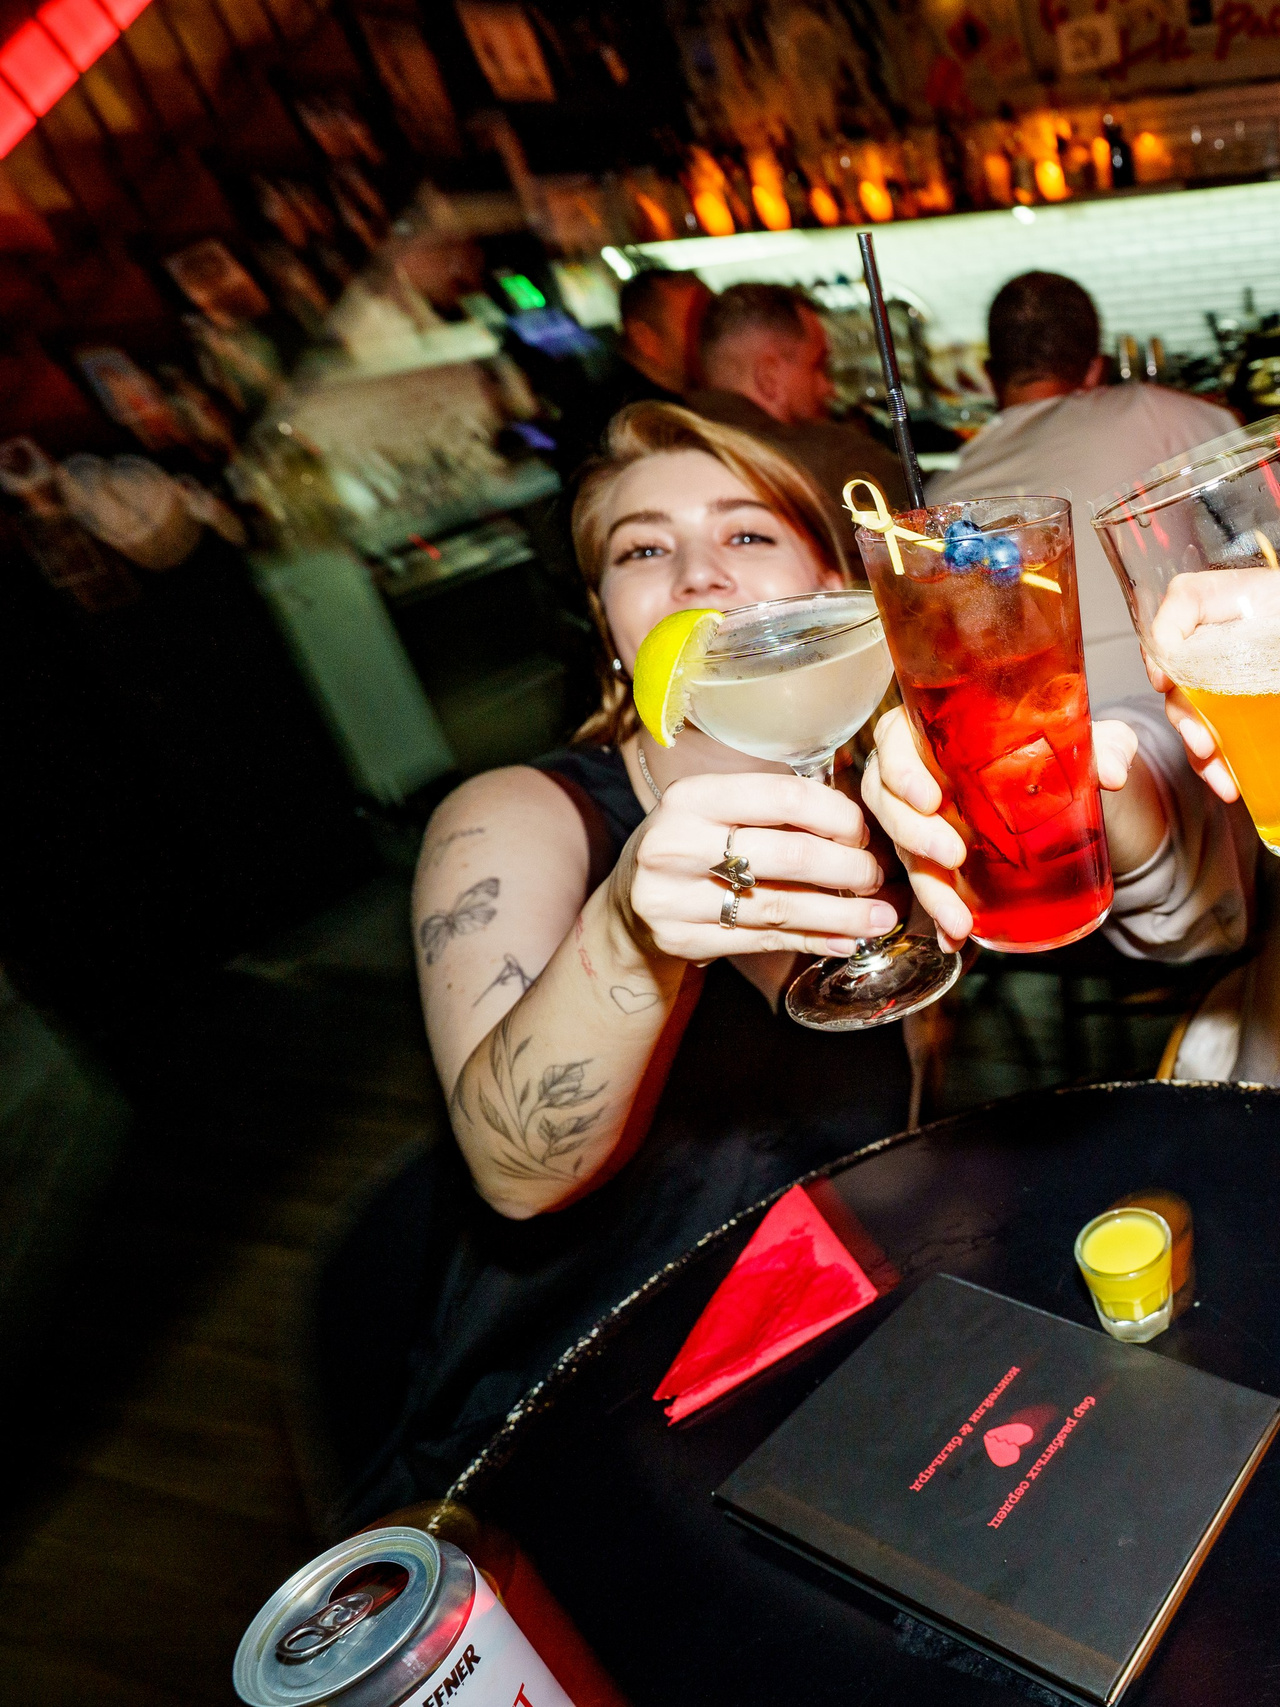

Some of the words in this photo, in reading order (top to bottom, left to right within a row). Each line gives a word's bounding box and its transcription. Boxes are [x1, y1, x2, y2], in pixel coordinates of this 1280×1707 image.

[728, 866, 739, 883] YES
[968, 1365, 1021, 1424] коктейли
[1073, 1395, 1096, 1420] бар
[958, 1422, 974, 1437] &
[1025, 1416, 1079, 1481] разбитых
[909, 1435, 964, 1492] бильярд
[987, 1480, 1030, 1529] сердец
